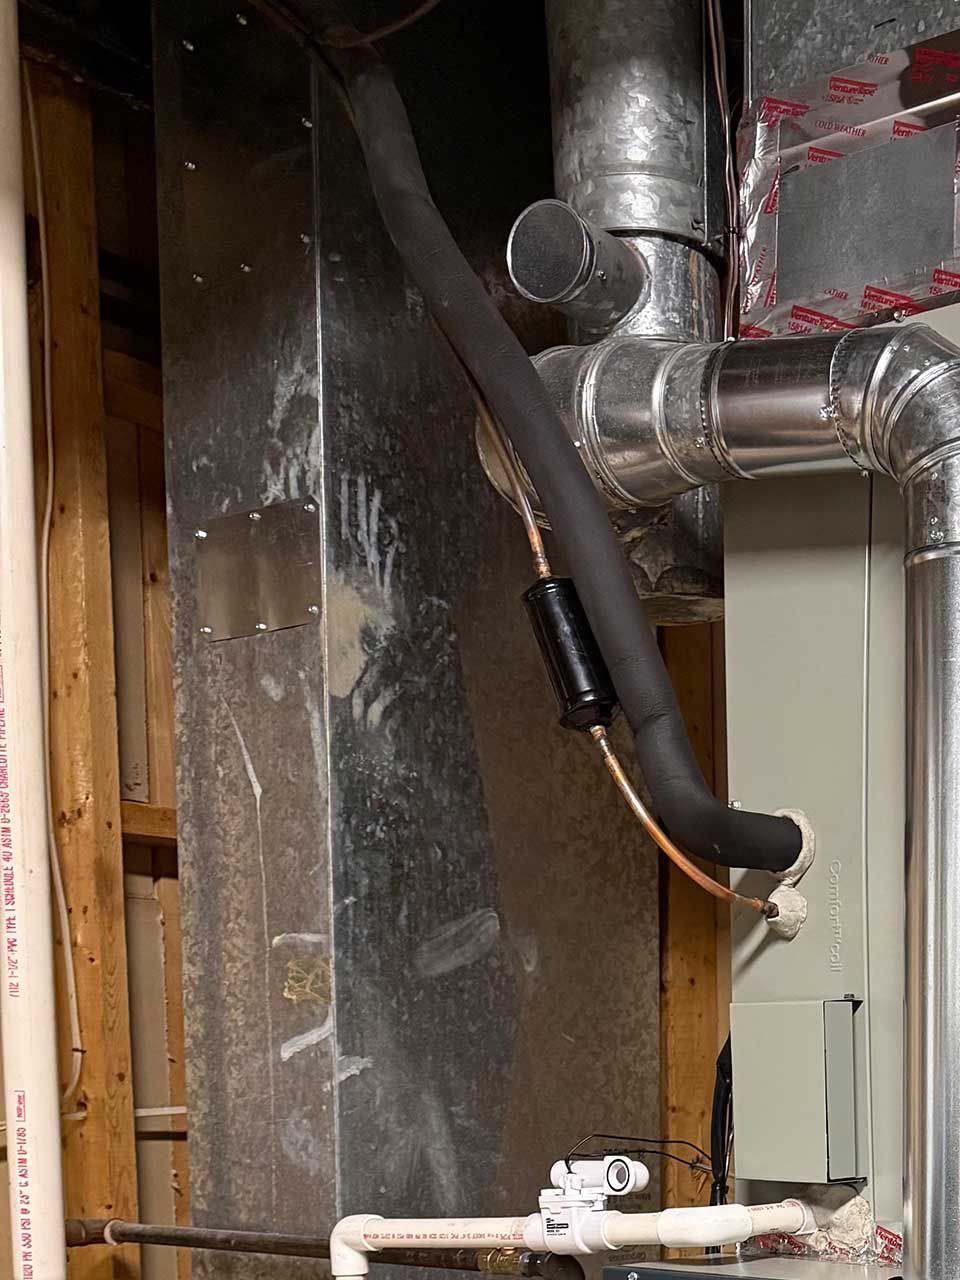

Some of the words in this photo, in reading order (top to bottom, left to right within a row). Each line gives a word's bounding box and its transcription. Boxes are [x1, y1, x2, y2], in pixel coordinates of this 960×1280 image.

[814, 120, 833, 130] COLD
[834, 124, 865, 137] WEATHER
[1, 827, 12, 848] ASTM
[17, 1158, 28, 1178] ASTM
